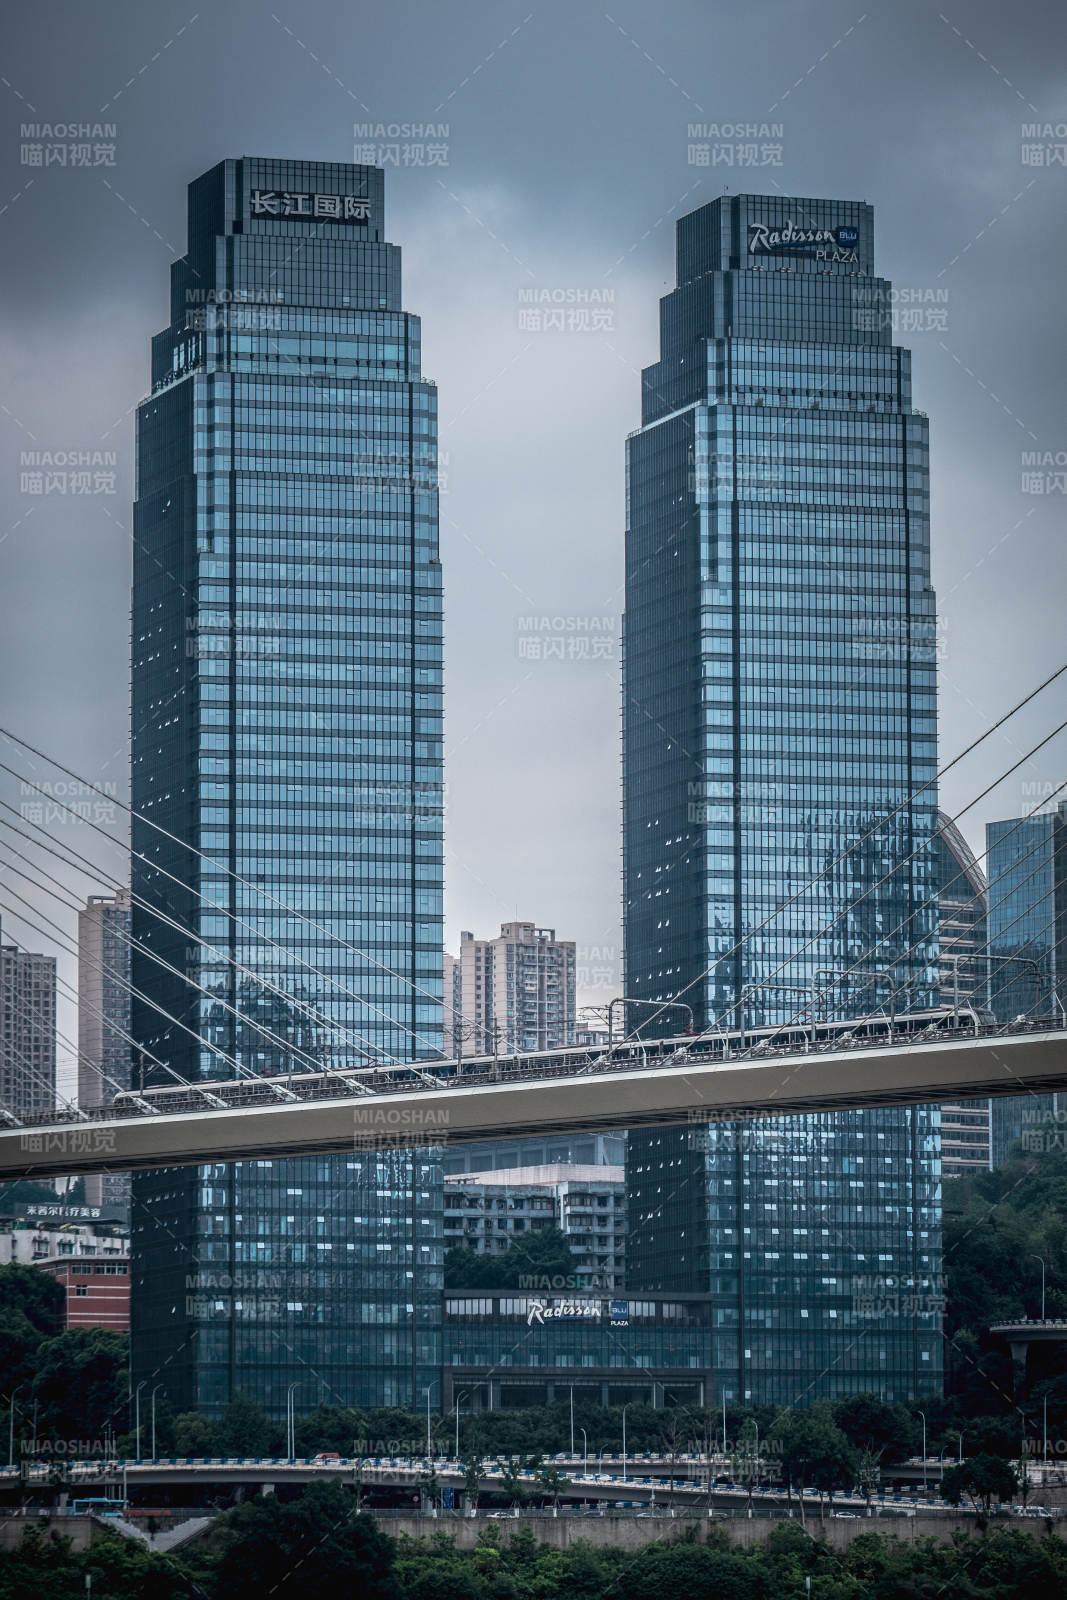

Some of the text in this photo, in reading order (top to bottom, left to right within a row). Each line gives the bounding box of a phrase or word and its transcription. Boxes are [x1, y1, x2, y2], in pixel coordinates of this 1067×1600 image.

[249, 191, 371, 219] 长江国际
[750, 220, 857, 253] Radisson BLU
[816, 250, 858, 263] PLAZA
[527, 1301, 601, 1326] Radisson
